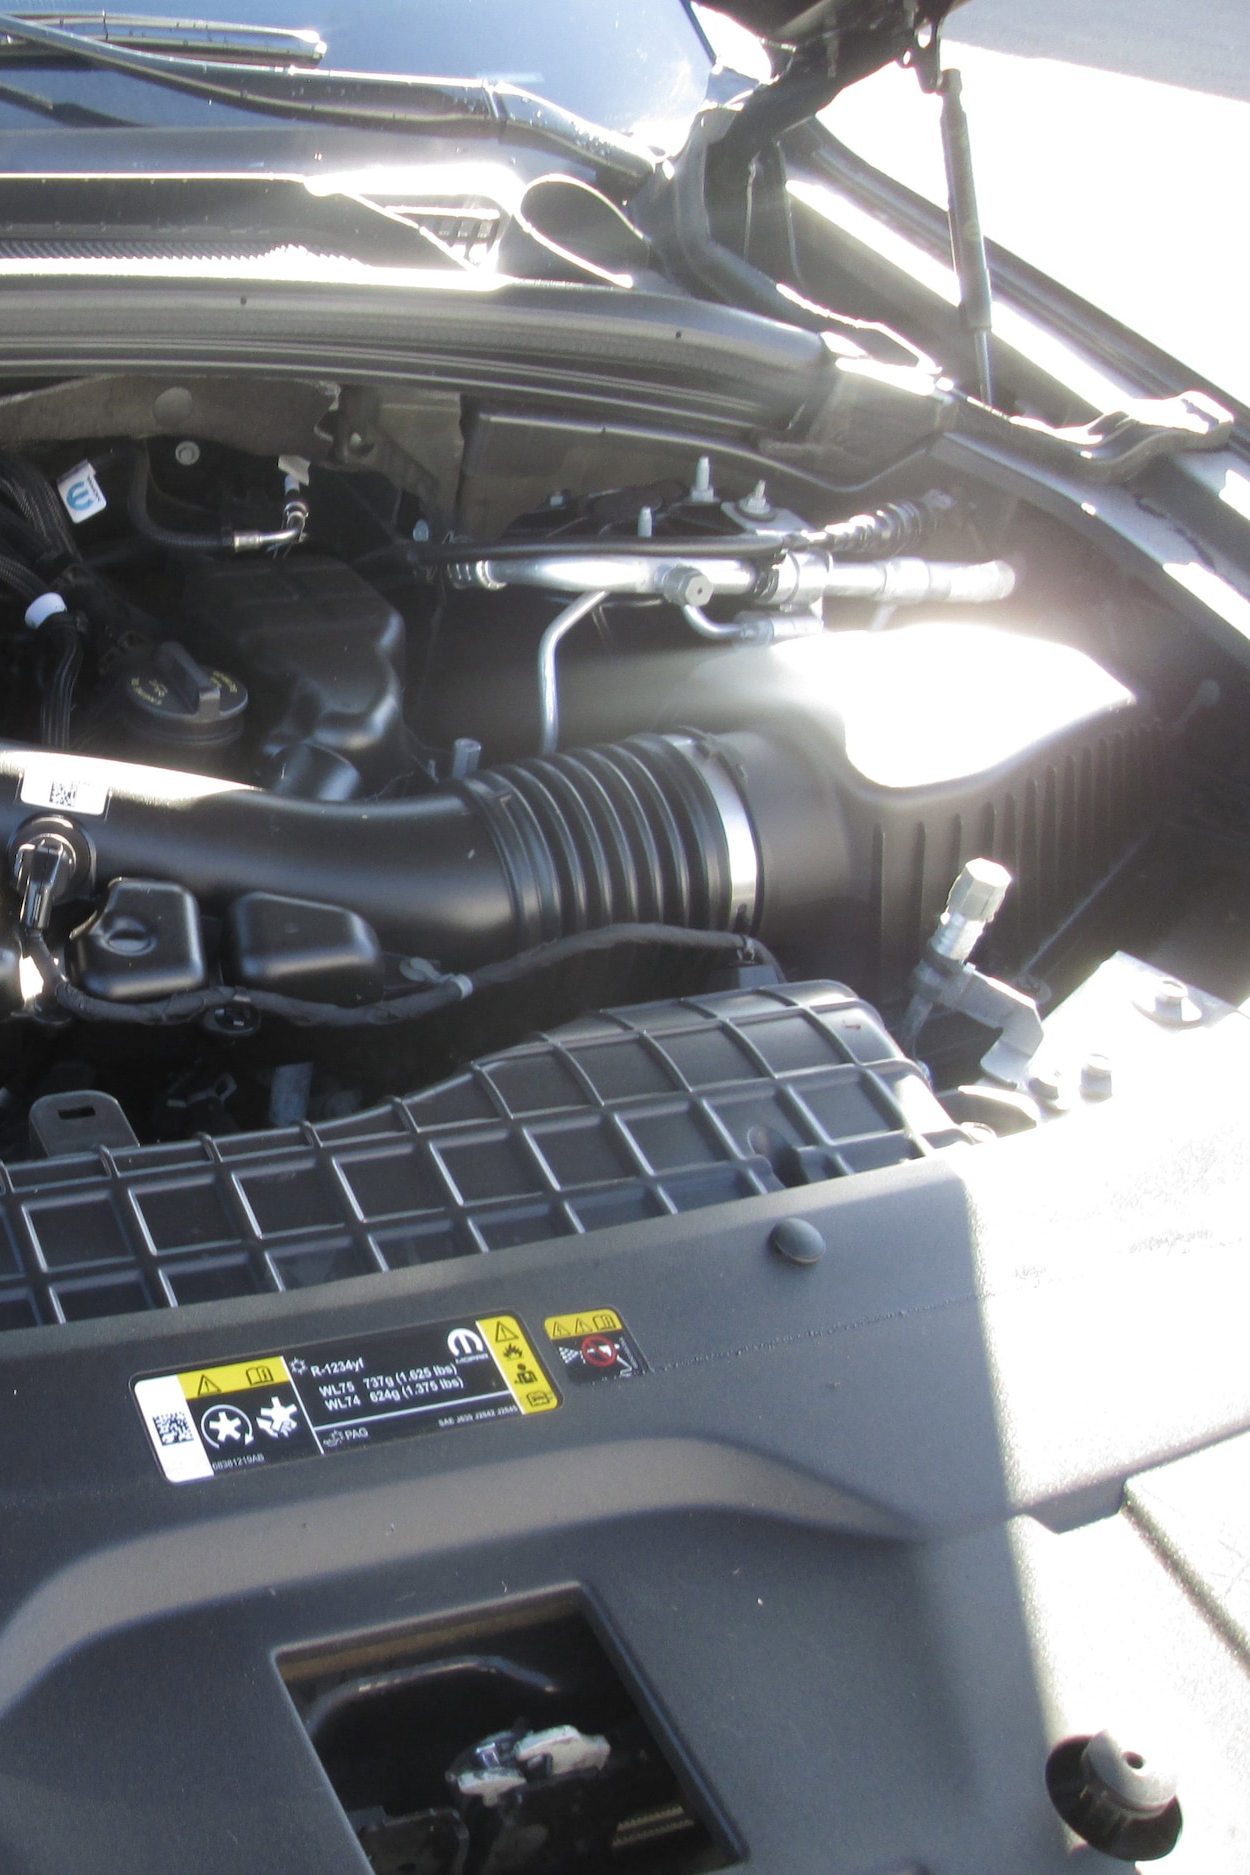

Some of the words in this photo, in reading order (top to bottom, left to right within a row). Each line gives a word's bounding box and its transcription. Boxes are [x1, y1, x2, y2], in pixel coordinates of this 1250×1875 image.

[310, 1357, 364, 1377] R-1234yf
[319, 1381, 355, 1398] WL75
[363, 1373, 395, 1390] 737g
[395, 1368, 432, 1386] (1.625
[433, 1363, 458, 1378] lbs)
[325, 1394, 361, 1412] WL74
[369, 1387, 400, 1404] 624g
[402, 1381, 438, 1399] (1.375
[439, 1375, 464, 1390] lbs)
[345, 1427, 369, 1441] PAG
